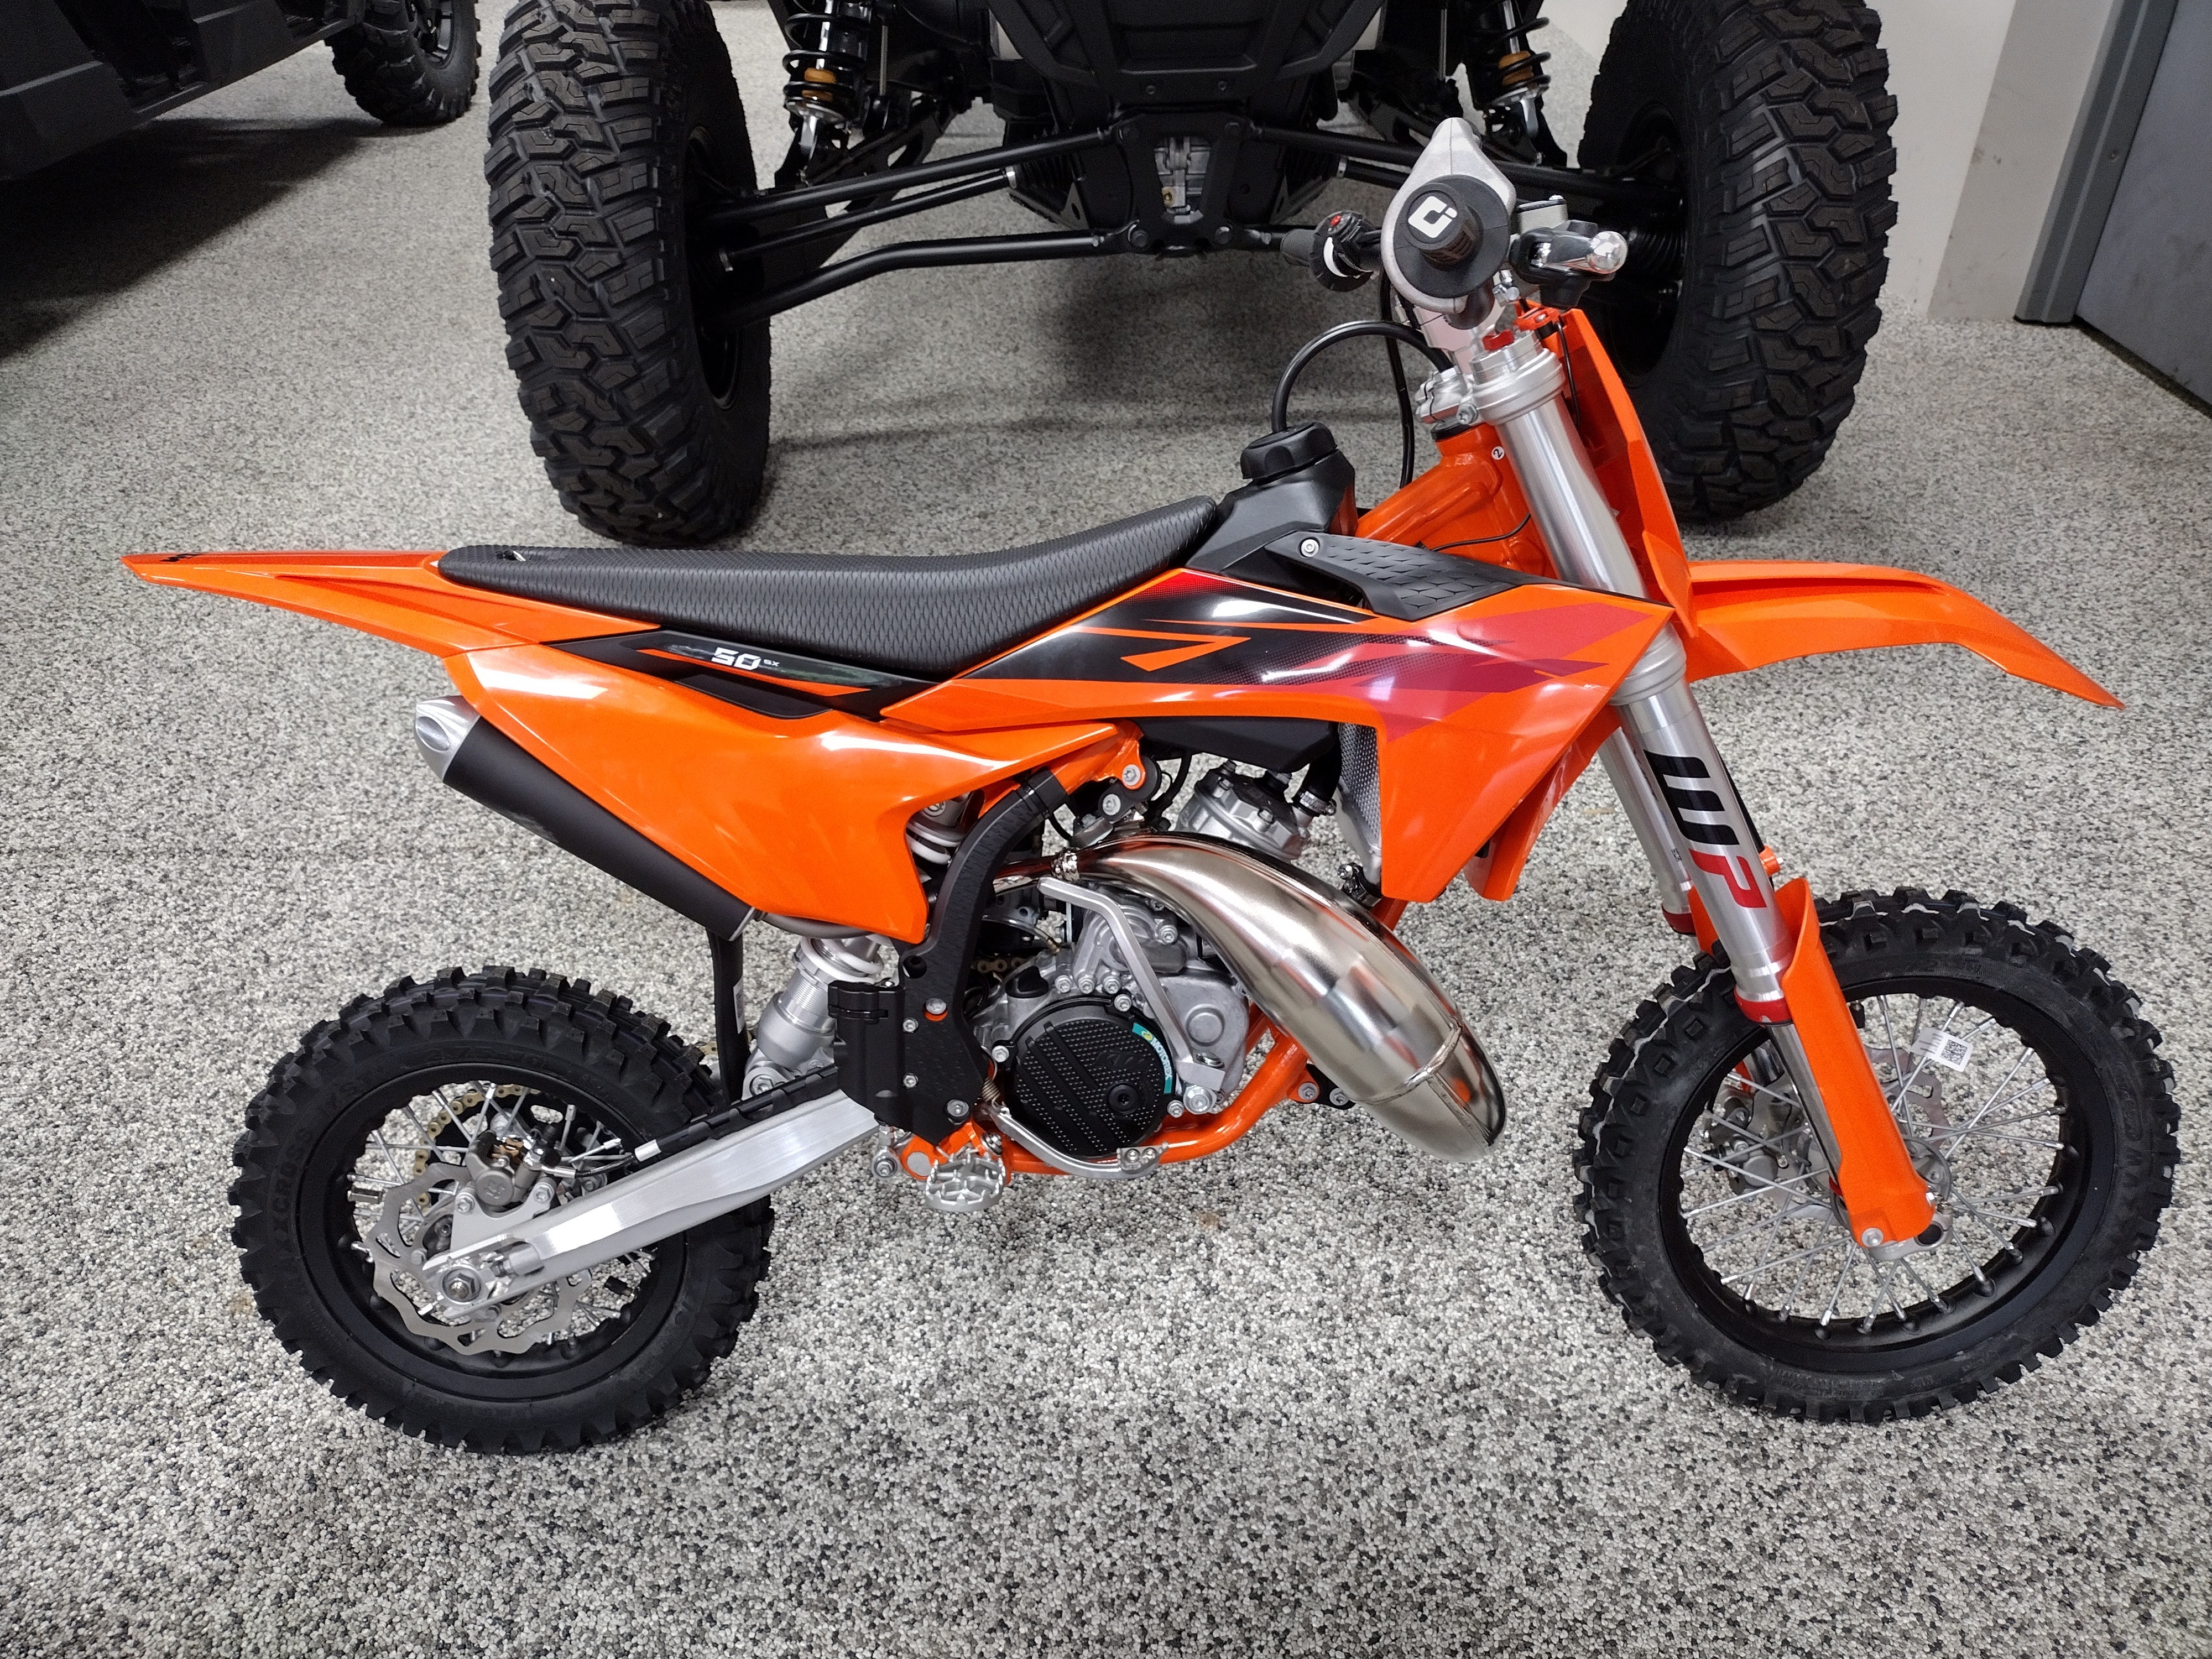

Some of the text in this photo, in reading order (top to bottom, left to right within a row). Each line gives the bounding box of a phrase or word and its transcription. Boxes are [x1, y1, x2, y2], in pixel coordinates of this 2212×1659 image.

[1493, 448, 1504, 458] 2
[711, 646, 761, 671] 50
[1643, 749, 1767, 909] WP
[1150, 1036, 1173, 1081] MOTOREX
